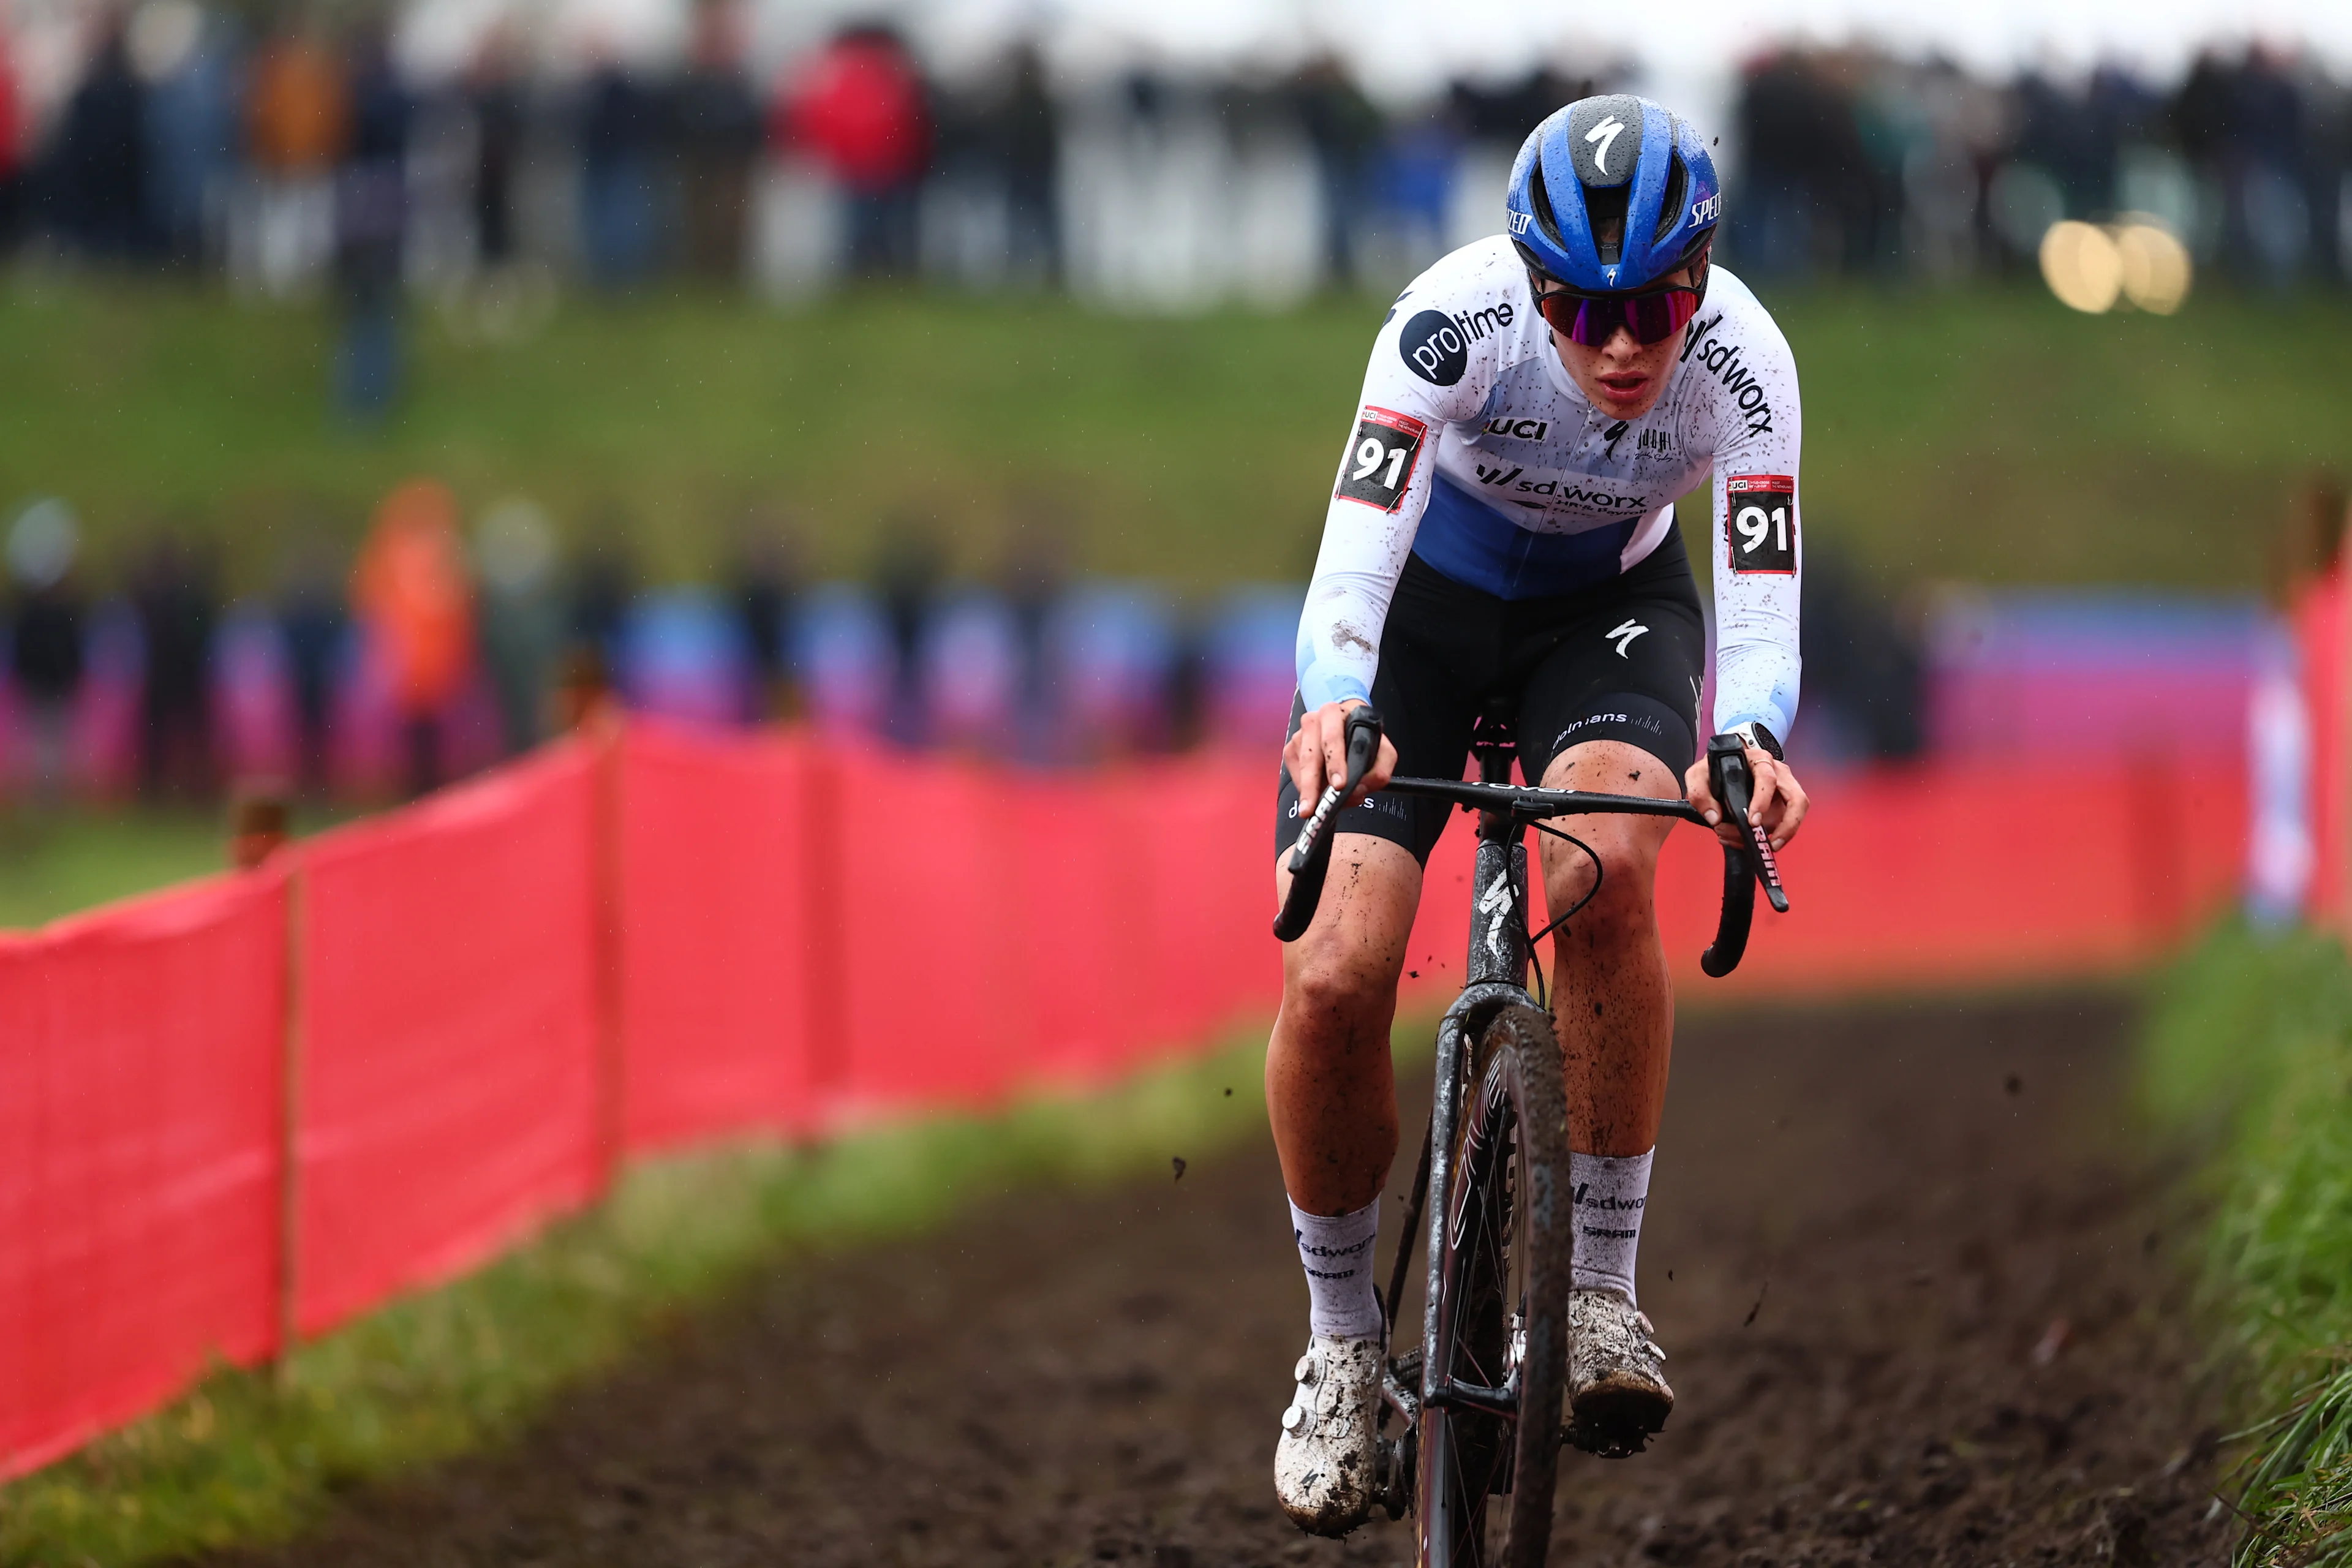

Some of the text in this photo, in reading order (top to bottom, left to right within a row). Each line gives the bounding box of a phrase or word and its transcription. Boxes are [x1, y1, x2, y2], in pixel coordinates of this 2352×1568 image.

[1412, 303, 1513, 380] protime
[1488, 418, 1548, 440] UCI
[1352, 437, 1407, 491] 91
[1597, 508, 1648, 516] Payroll
[1736, 507, 1787, 554] 91
[1743, 807, 1781, 886] RAM
[1583, 1226, 1636, 1238] SRAM
